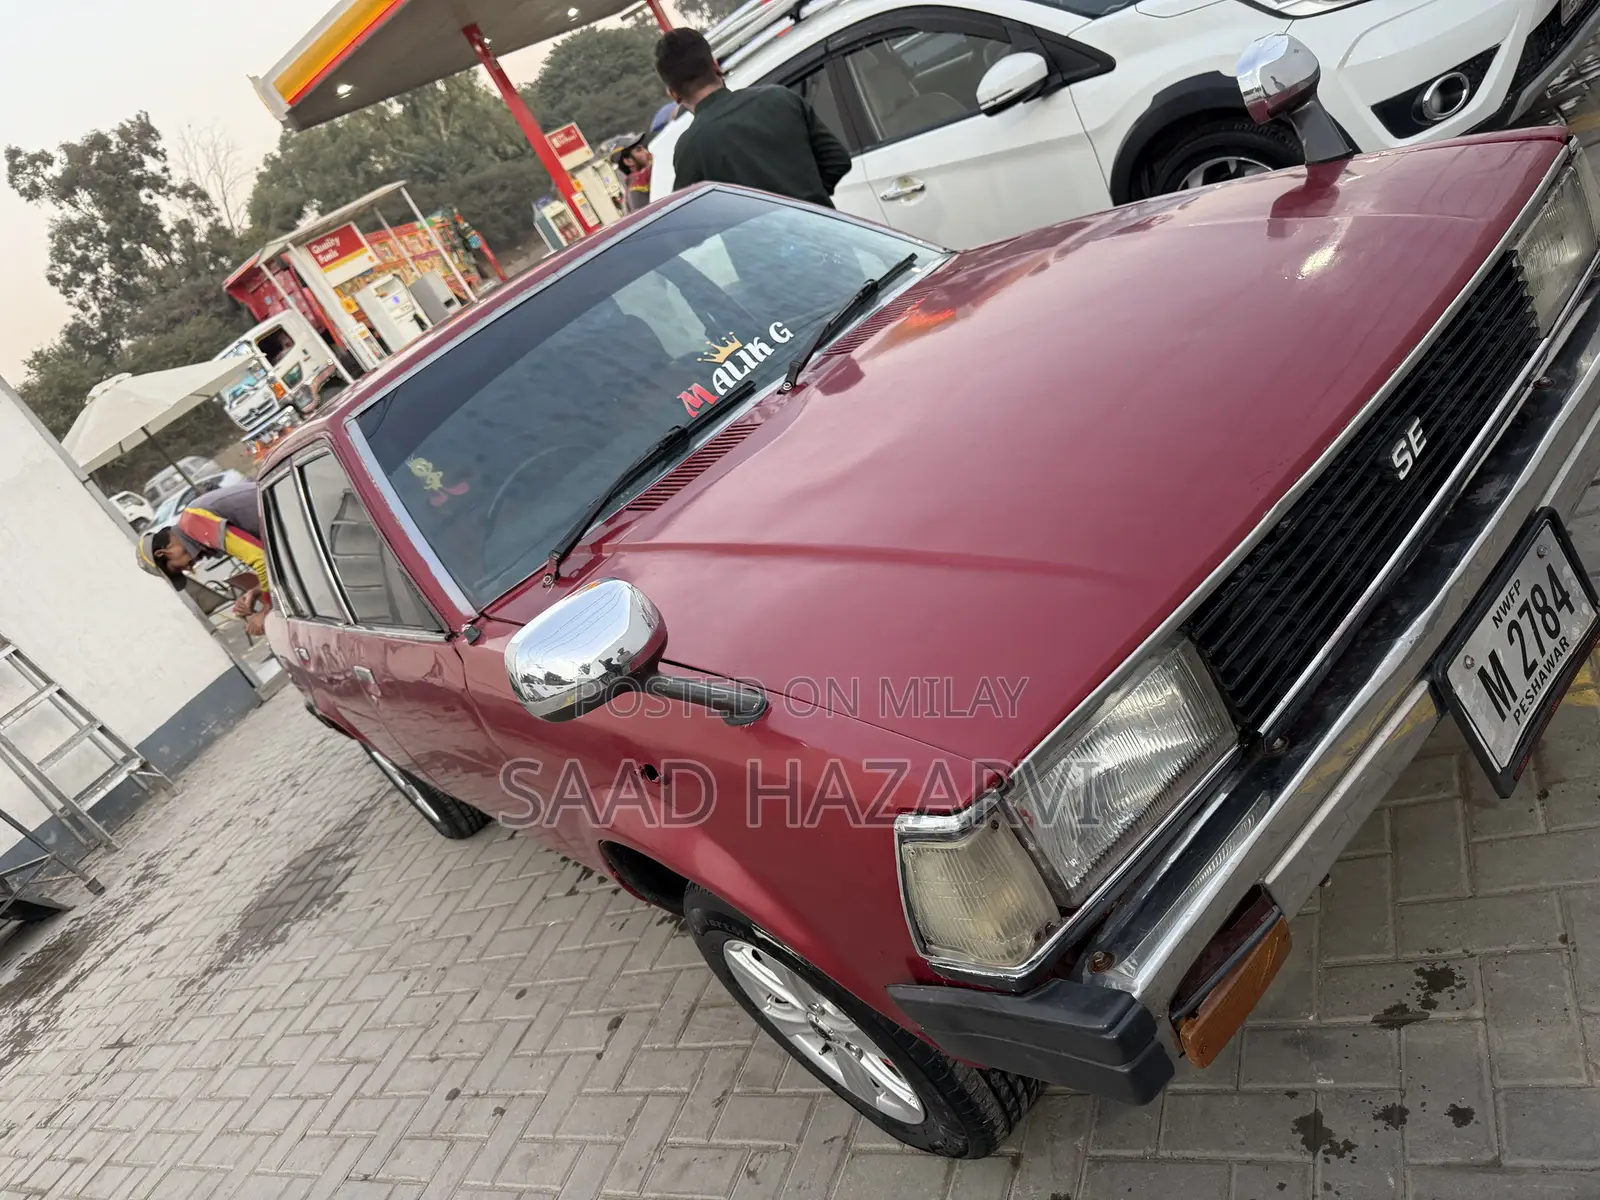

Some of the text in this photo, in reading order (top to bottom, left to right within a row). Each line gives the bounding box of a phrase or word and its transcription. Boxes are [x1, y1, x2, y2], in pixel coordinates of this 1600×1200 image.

[769, 321, 794, 344] G
[1391, 416, 1427, 480] SE
[1491, 578, 1522, 629] NWFP
[1476, 563, 1576, 722] M 2784
[1512, 636, 1570, 726] PESHAWAR
